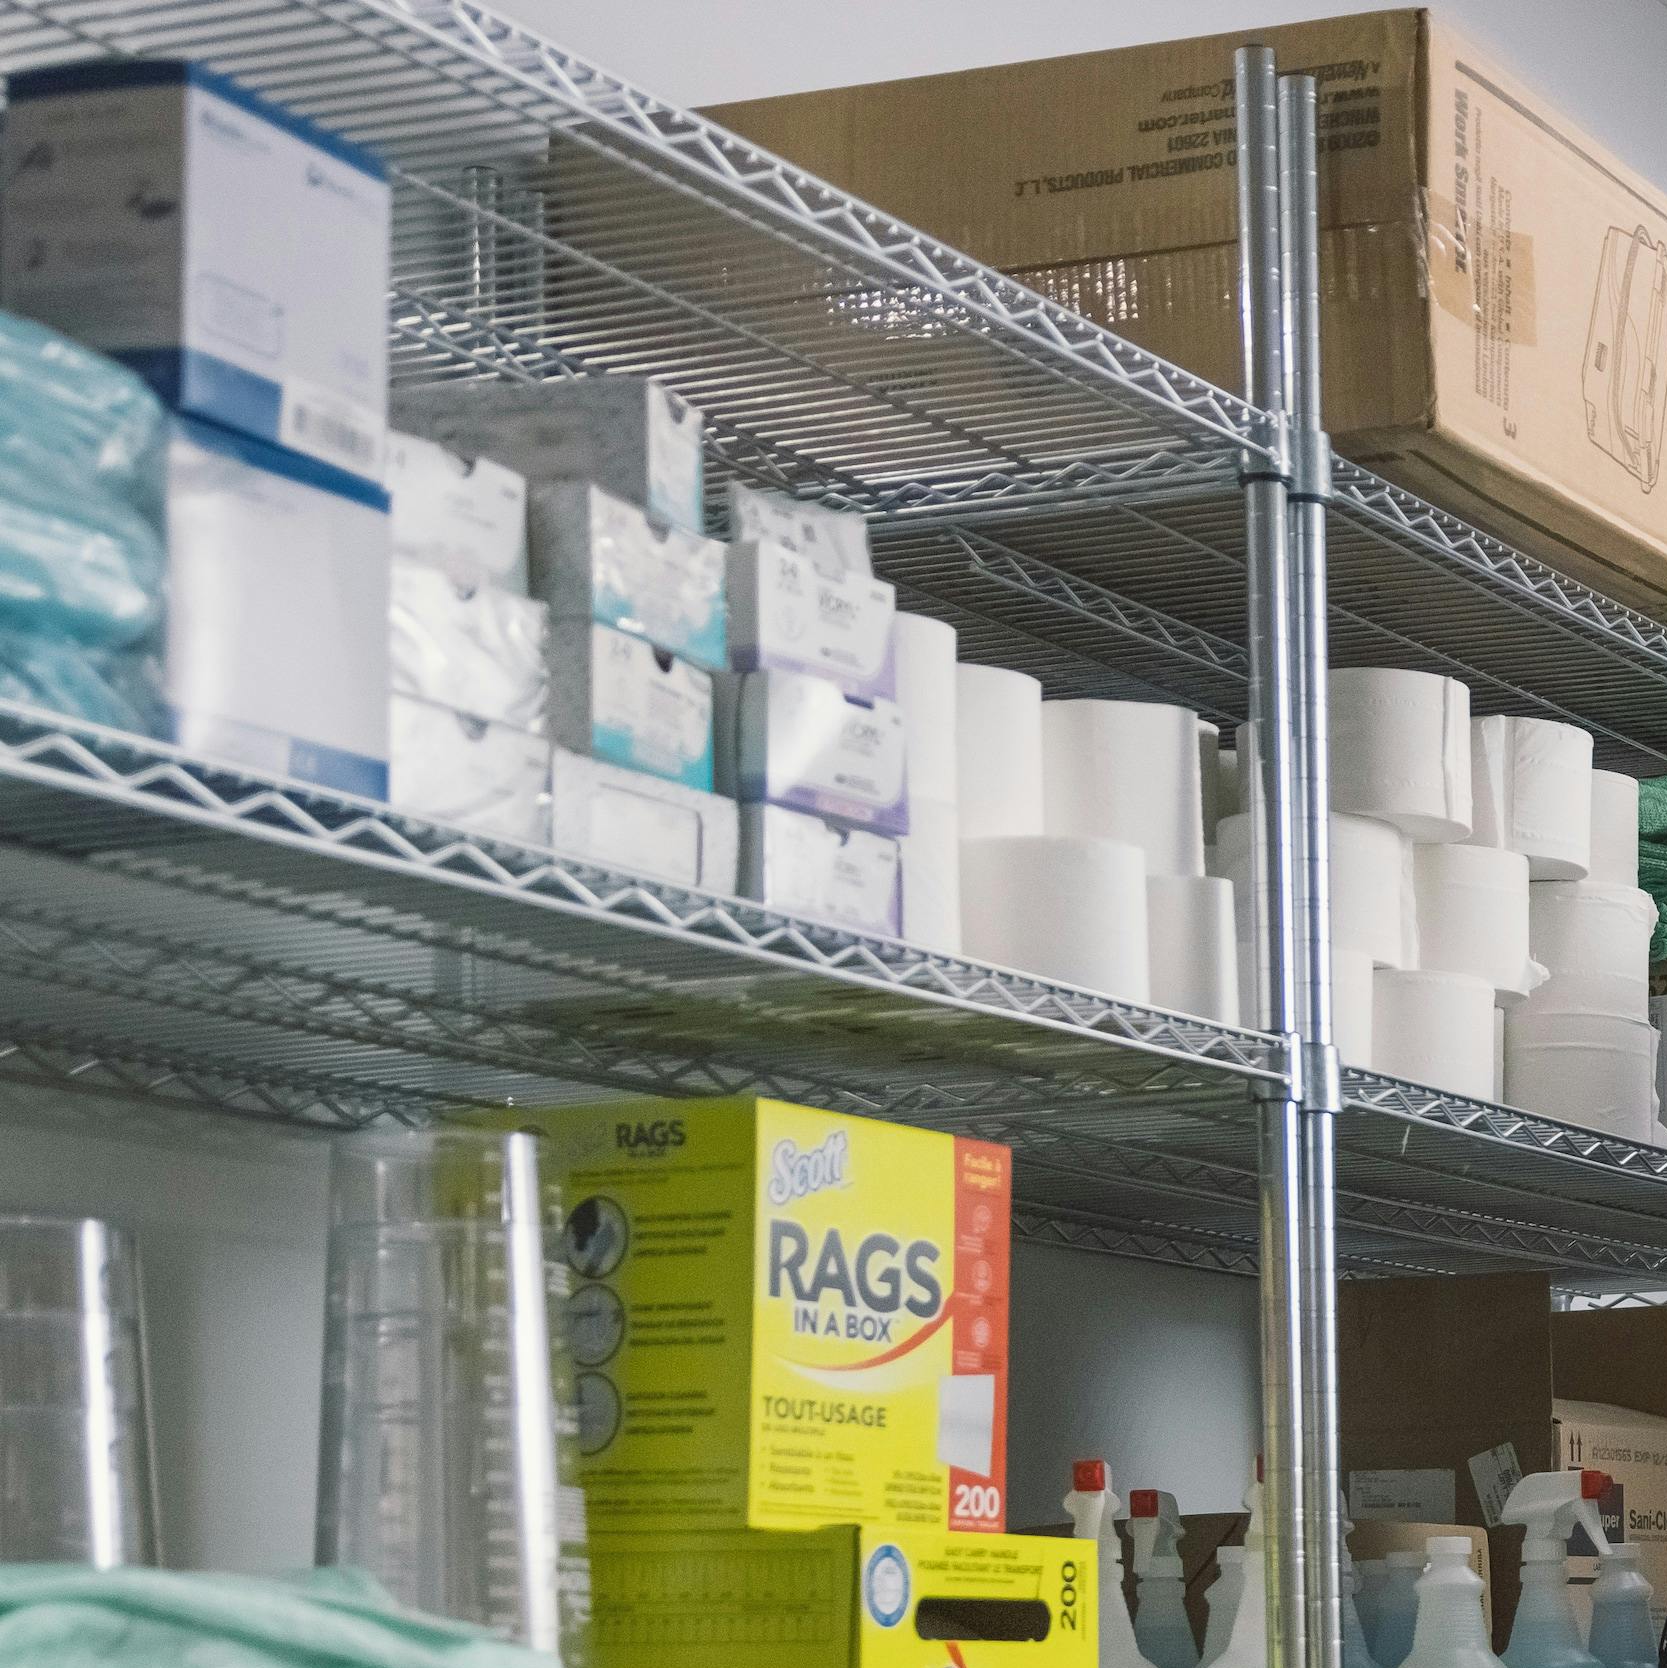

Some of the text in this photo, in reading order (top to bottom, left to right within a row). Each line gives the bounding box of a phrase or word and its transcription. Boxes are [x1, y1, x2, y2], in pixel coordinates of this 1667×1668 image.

[1161, 83, 1220, 104] Company
[1455, 88, 1468, 159] Work
[1126, 152, 1223, 181] COMMERCIAL
[1503, 417, 1518, 440] 3
[616, 1120, 687, 1149] RAGS
[768, 1130, 847, 1206] Scott
[768, 1218, 942, 1319] RAGS
[794, 1306, 892, 1342] IN A BOX
[762, 1395, 886, 1428] TOUT-USAGE
[954, 1484, 1000, 1519] 200
[1600, 1514, 1620, 1532] uper
[1060, 1561, 1077, 1632] 200
